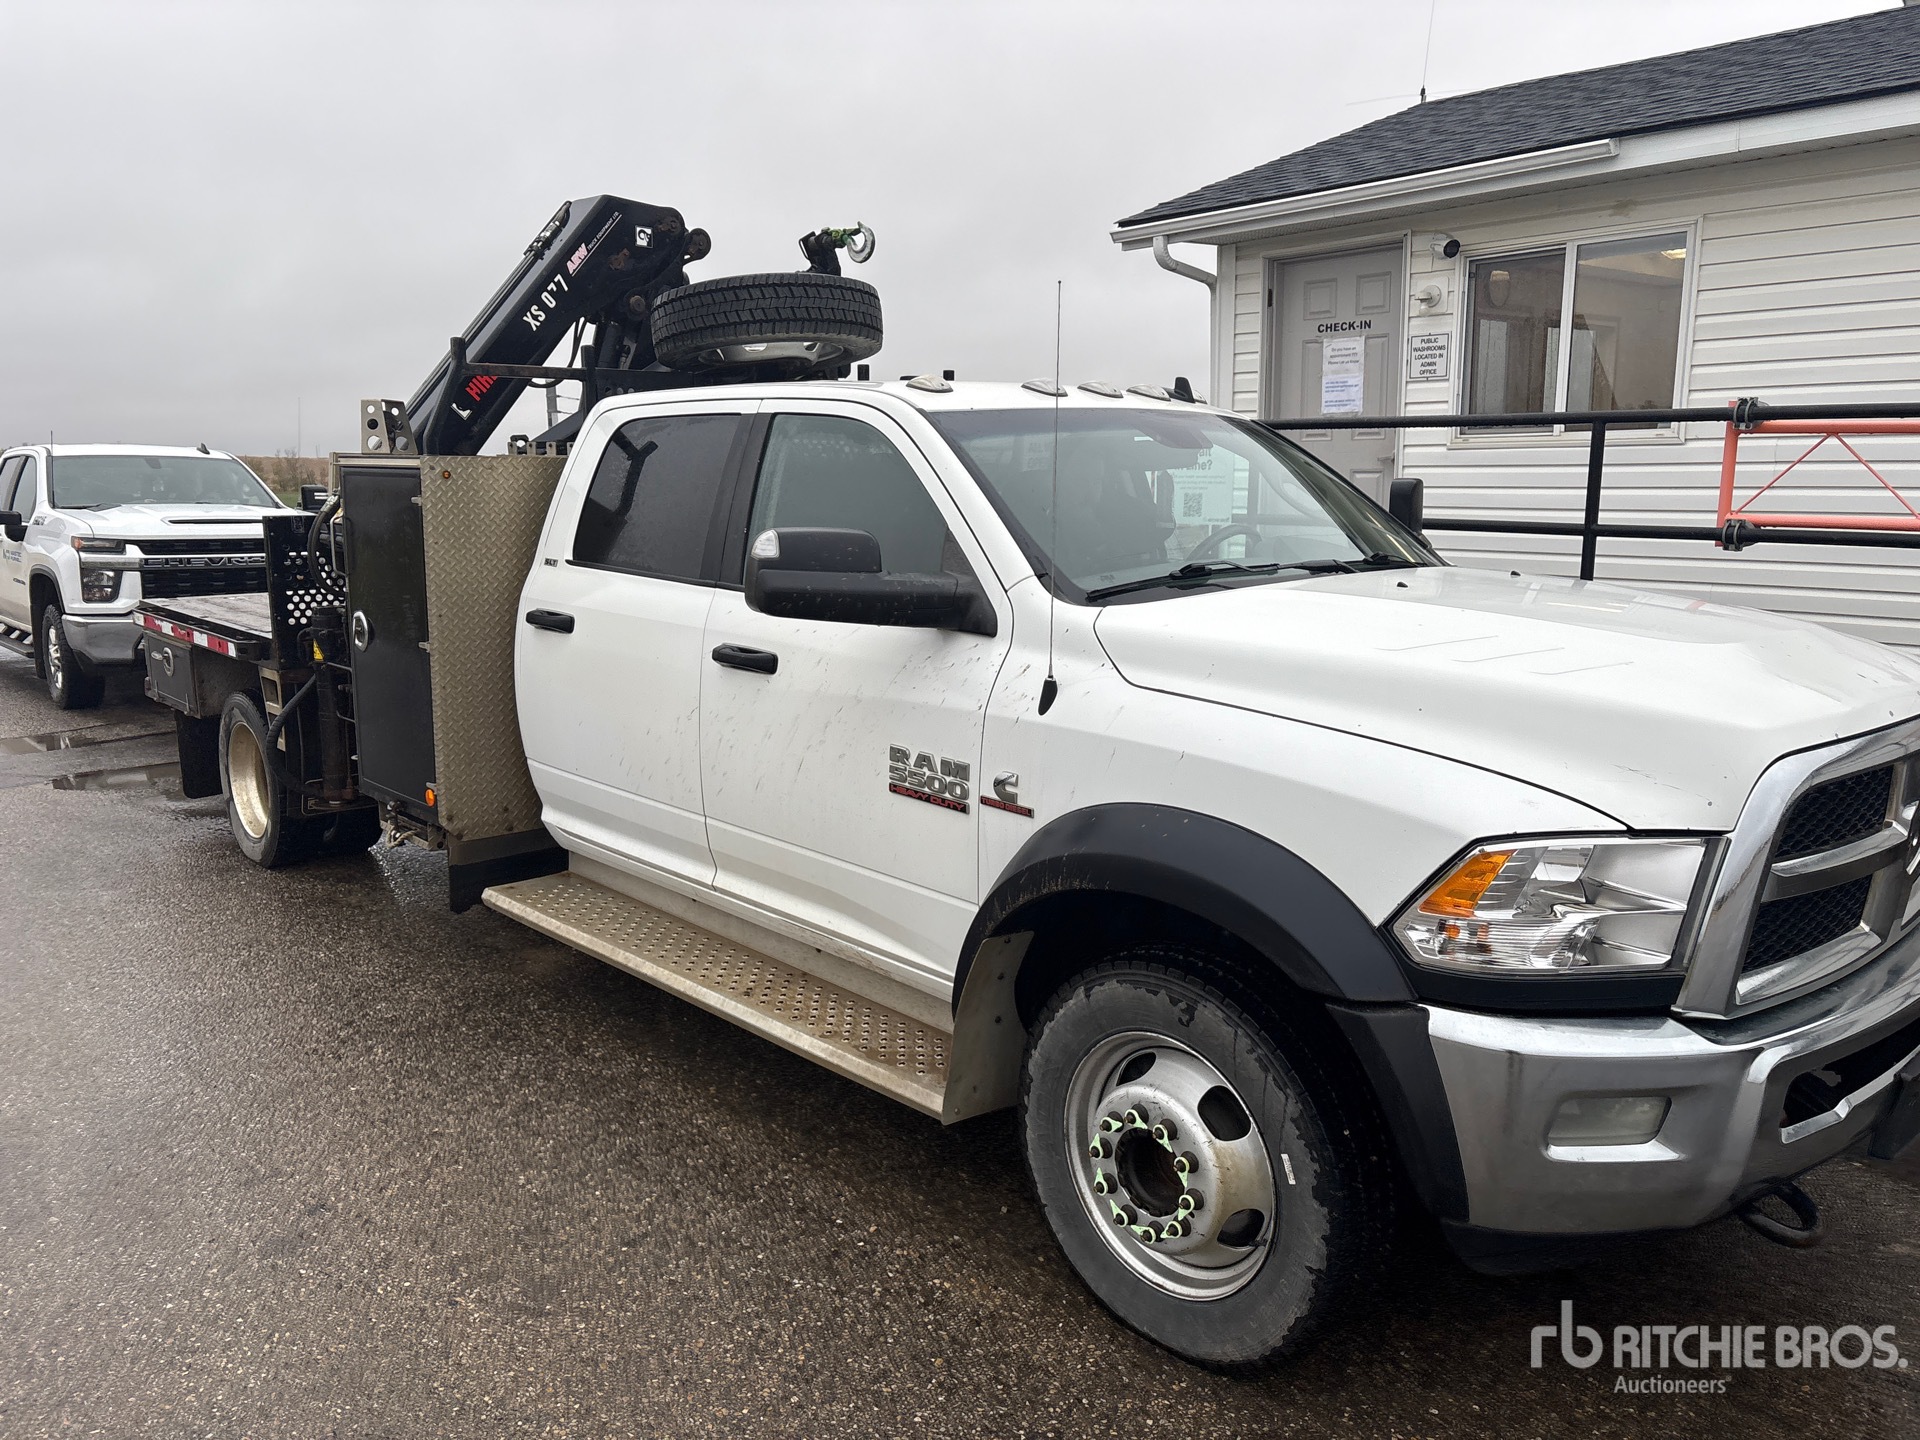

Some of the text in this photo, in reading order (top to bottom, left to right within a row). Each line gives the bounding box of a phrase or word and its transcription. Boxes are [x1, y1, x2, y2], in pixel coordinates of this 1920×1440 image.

[587, 237, 598, 250] TRUCK
[596, 217, 614, 239] EQUIPMENT
[522, 304, 546, 332] XS
[1317, 319, 1372, 333] CHECK-IN
[465, 375, 498, 402] HIA
[1199, 448, 1212, 457] ait
[889, 743, 970, 782] RAM
[888, 762, 970, 801] 5500
[890, 784, 966, 812] HEAVY DUTY
[981, 797, 1031, 816] TURBO DIESEL
